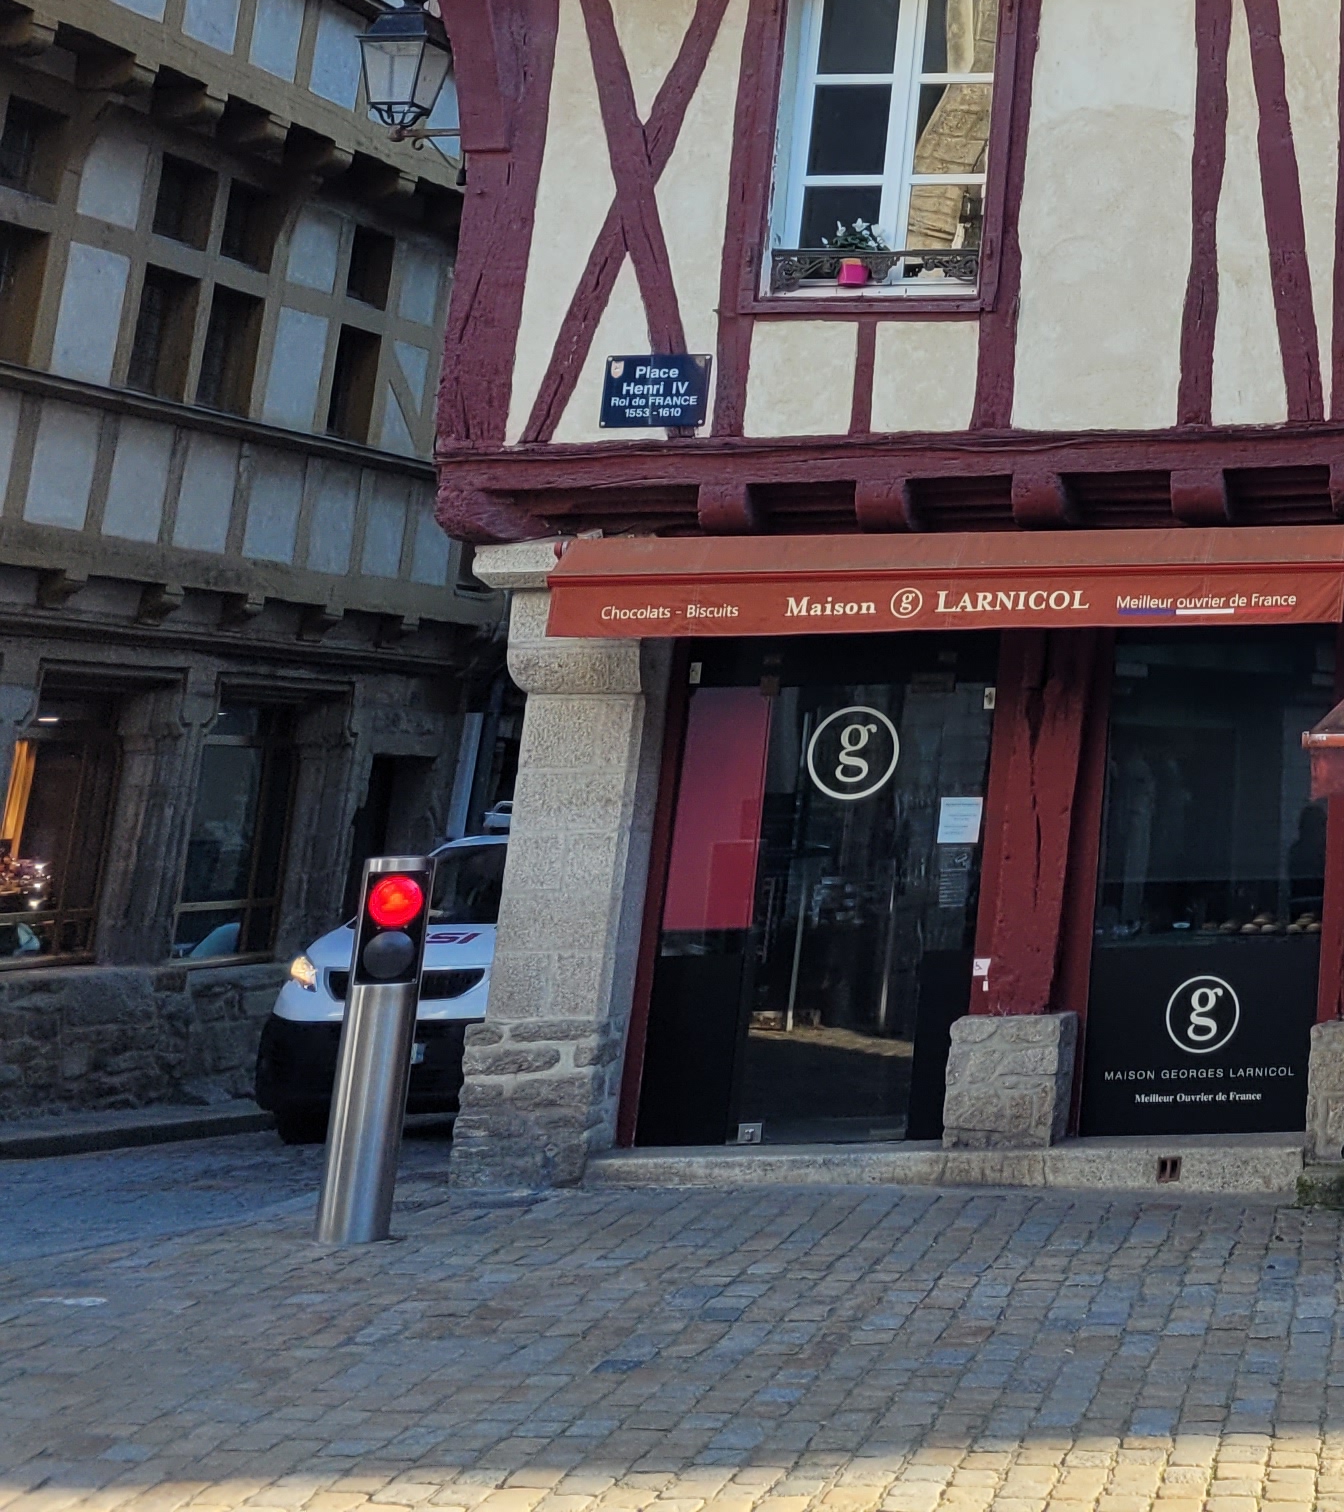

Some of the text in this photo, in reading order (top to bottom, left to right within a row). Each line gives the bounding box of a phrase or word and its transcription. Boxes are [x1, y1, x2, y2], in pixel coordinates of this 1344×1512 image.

[635, 366, 679, 379] Place
[622, 381, 689, 395] Henri IV
[611, 396, 698, 407] Roi de FRANCE
[601, 606, 671, 620] Chocolats
[686, 603, 739, 619] Biscuits
[785, 596, 877, 617] Maison
[934, 590, 1090, 613] LARNICOL
[1116, 593, 1297, 609] Meilleur ouvrier de France
[1103, 1066, 1295, 1081] MAISON GEORGES LARNICOL
[1134, 1091, 1262, 1103] Meilleur Ouvrier de France
